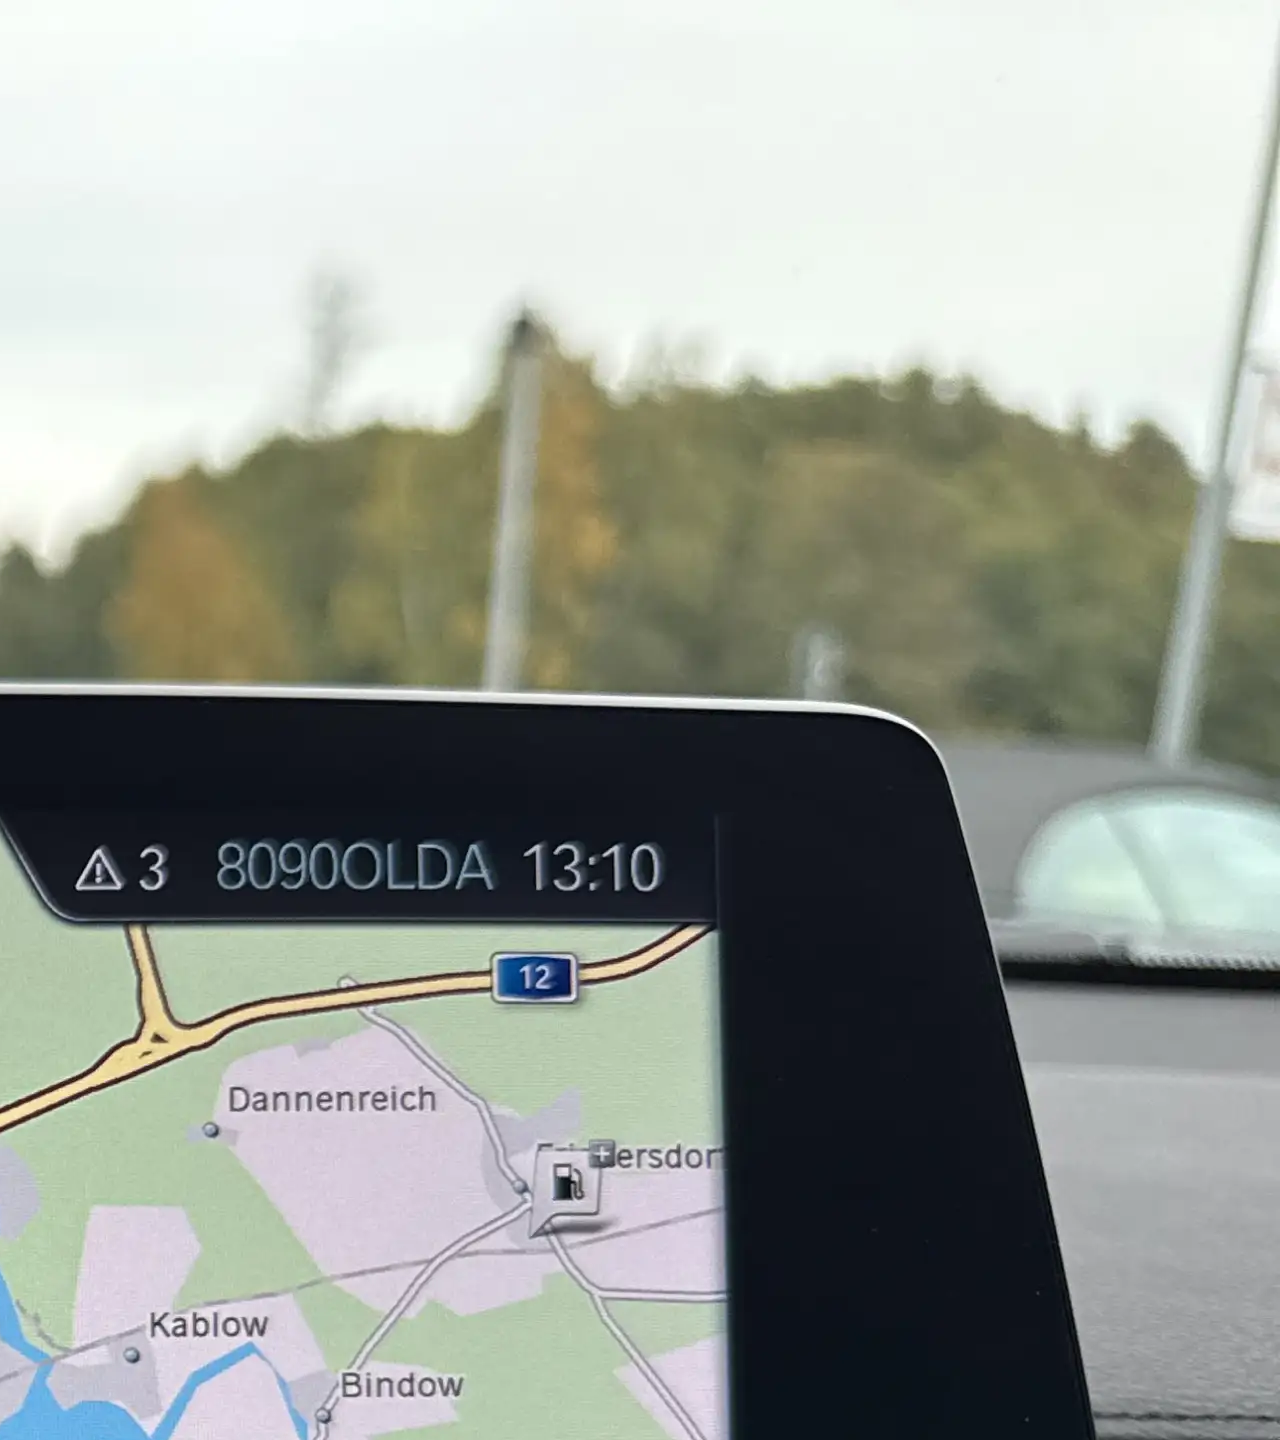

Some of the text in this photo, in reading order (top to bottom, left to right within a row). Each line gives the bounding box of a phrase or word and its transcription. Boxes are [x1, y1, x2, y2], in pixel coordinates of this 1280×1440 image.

[139, 847, 168, 892] 3
[524, 843, 663, 892] 13:10
[519, 964, 553, 990] 12
[228, 1085, 438, 1113] Dannenreich
[149, 1312, 268, 1338] Kablow
[341, 1371, 464, 1398] Bindow
